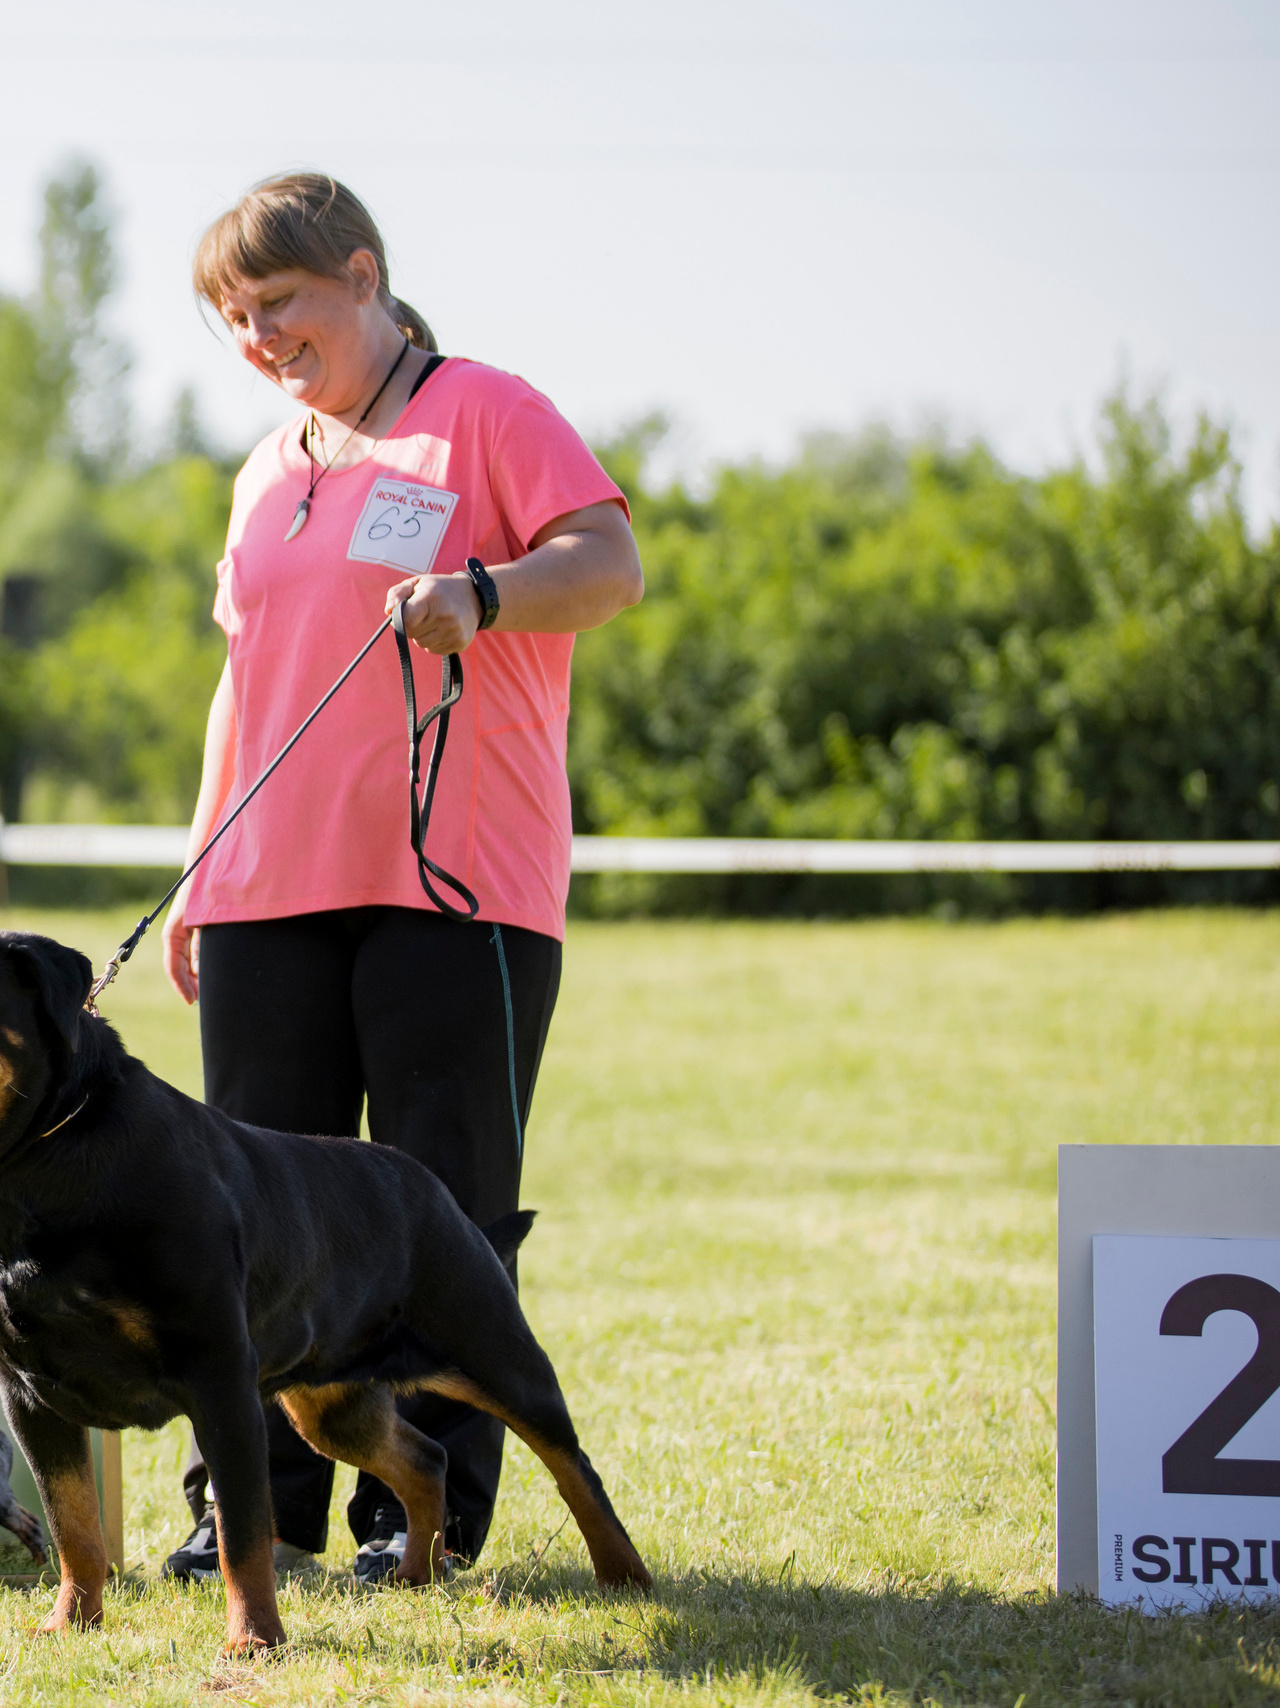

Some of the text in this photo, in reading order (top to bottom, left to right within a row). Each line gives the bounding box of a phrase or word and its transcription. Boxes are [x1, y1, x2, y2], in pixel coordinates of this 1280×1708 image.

[368, 506, 433, 539] 65
[376, 490, 447, 514] ROYAL CANIN
[1159, 1273, 1280, 1497] 2
[1114, 1534, 1123, 1582] PREMIUM
[1132, 1534, 1280, 1587] SIRI
